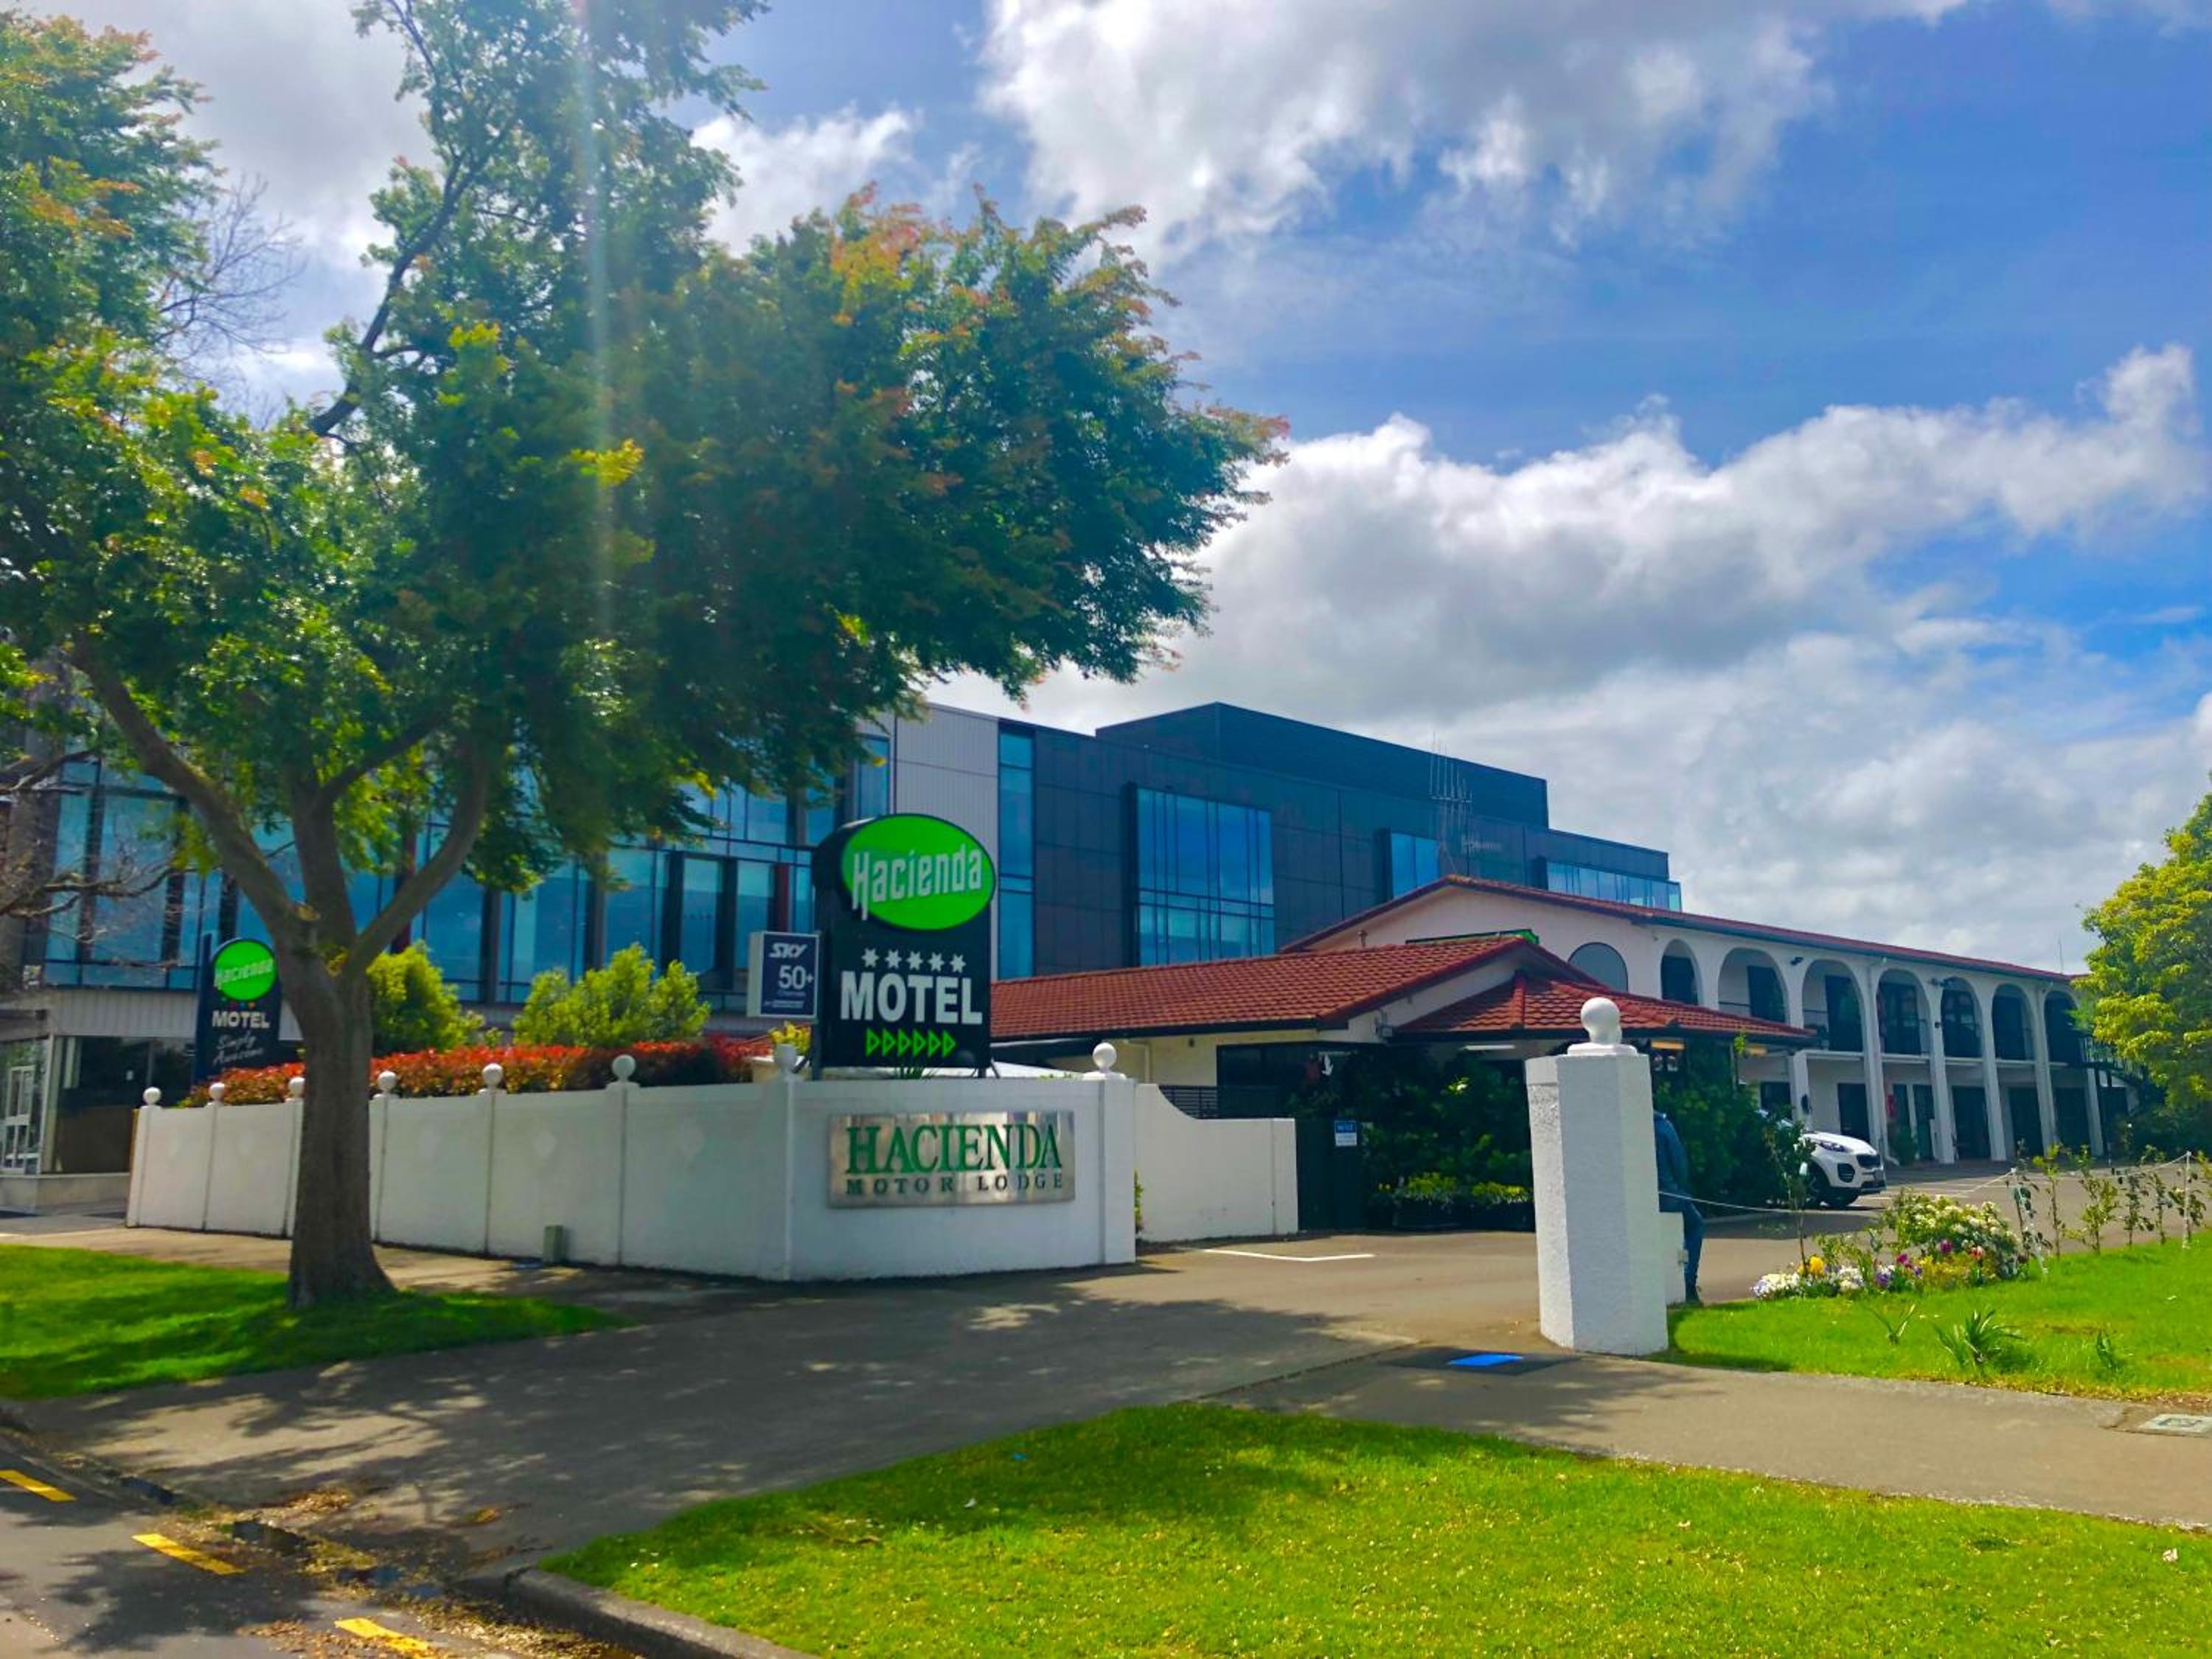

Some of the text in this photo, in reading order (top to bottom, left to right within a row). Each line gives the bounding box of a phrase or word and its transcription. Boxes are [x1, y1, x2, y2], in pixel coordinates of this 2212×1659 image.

[852, 845, 981, 920] Hacienda
[769, 942, 807, 958] SKY
[779, 964, 813, 990] 50+
[841, 970, 982, 1024] MOTEL
[212, 1010, 270, 1029] MOTEL
[846, 1124, 1062, 1174] HACIENDA
[846, 1173, 1062, 1194] MOTOR LODGE
